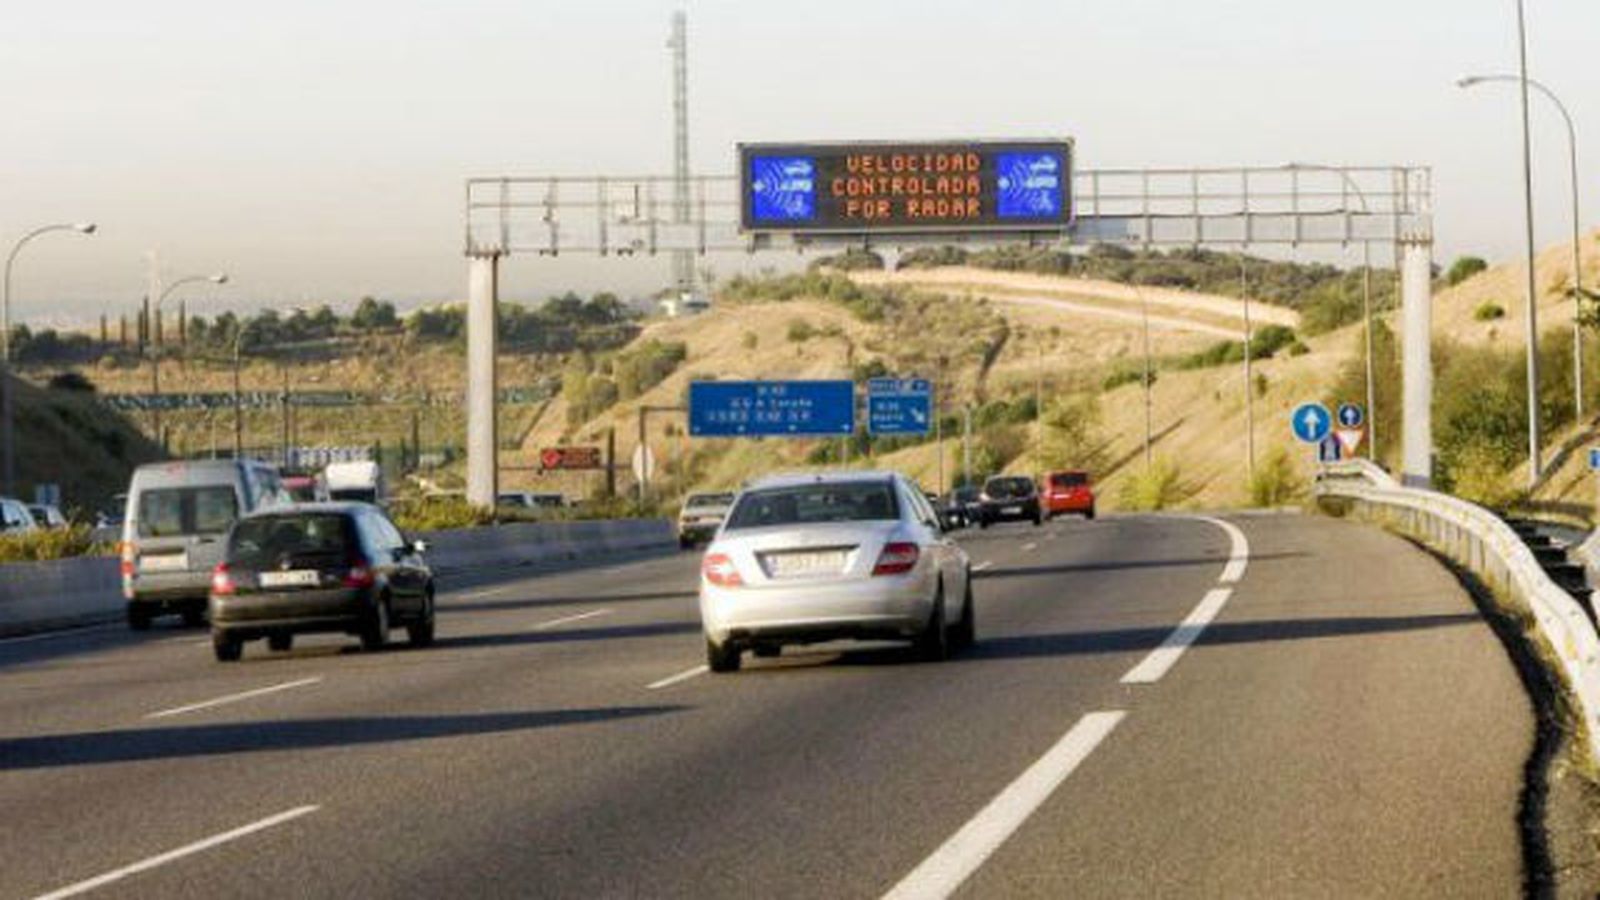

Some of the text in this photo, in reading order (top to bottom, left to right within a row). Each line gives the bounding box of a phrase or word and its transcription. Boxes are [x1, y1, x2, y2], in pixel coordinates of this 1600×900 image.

[846, 154, 981, 173] VELOCIDAD
[831, 177, 981, 196] CONTROLADA
[846, 198, 981, 218] POR RADAR
